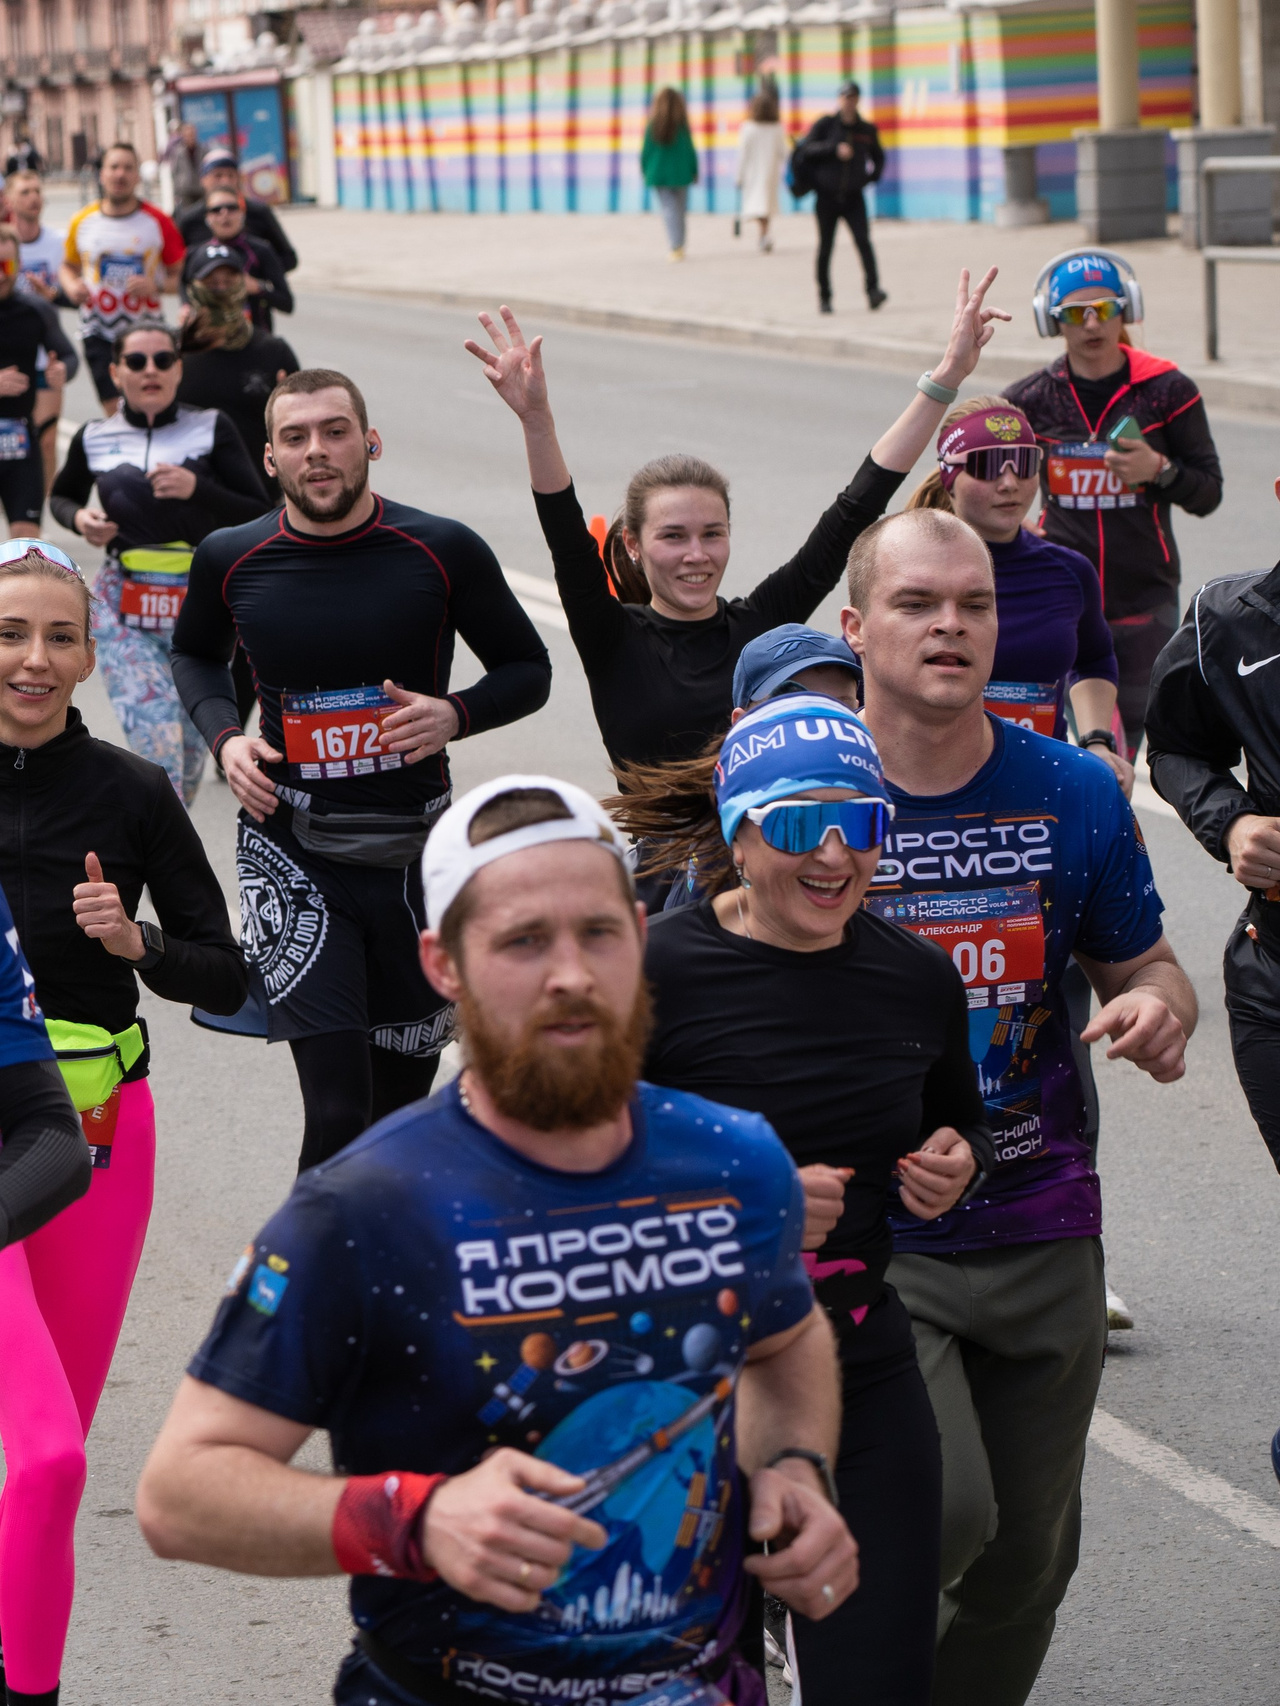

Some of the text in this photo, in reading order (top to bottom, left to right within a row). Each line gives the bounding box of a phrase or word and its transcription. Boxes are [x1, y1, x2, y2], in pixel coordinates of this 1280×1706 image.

[1069, 468, 1123, 494] 1770
[140, 593, 180, 616] 1161
[311, 722, 381, 759] 1672
[870, 846, 1053, 883] ОСМОС
[918, 904, 989, 918] КОСМОС
[930, 897, 988, 907] ПРОСТО
[285, 910, 320, 965] BLOOD
[918, 923, 983, 936] АЛЕКСАНДР
[952, 938, 1006, 984] 06
[92, 1106, 104, 1119] E
[461, 1240, 745, 1315] КОСМОС
